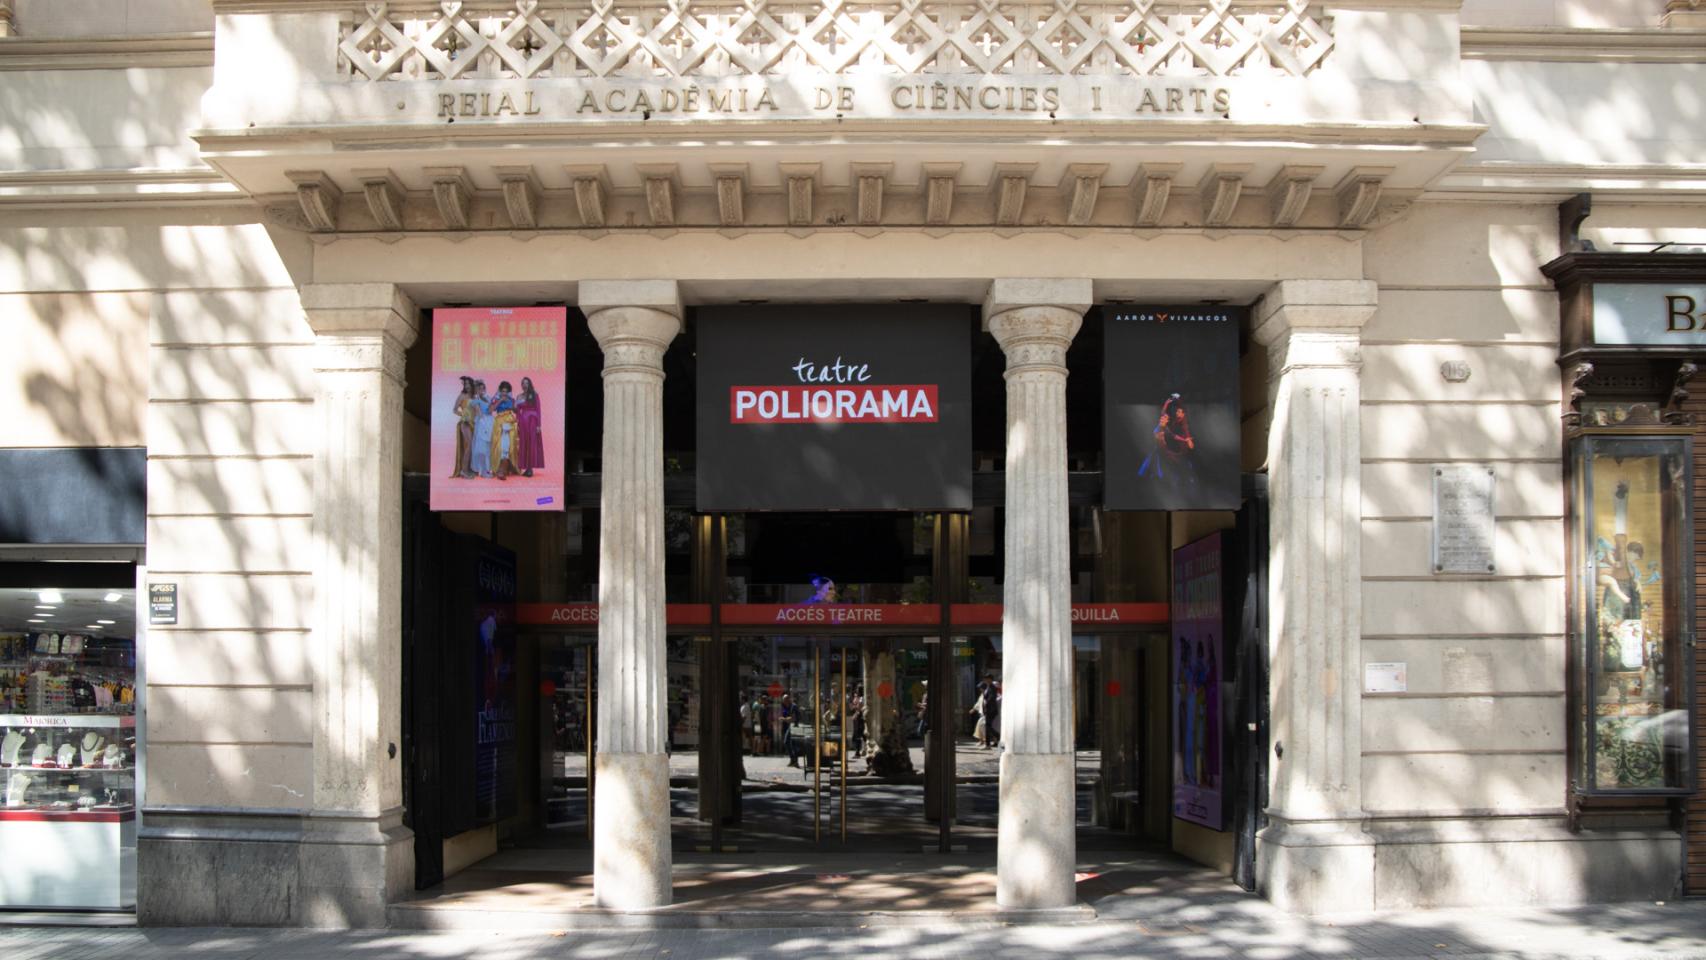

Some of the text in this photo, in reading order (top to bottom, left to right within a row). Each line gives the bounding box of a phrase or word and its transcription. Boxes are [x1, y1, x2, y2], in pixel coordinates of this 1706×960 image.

[437, 91, 541, 117] REIAL
[812, 86, 856, 111] DE
[890, 80, 1060, 112] CIÈNCIES
[1091, 86, 1102, 111] I
[1135, 87, 1231, 113] ARTS
[442, 336, 558, 371] EL CUENTO
[792, 356, 871, 383] teatre
[735, 389, 934, 419] POLIORAMA
[551, 605, 599, 621] ACCÉS
[776, 606, 883, 621] ACCÉS TEATRE
[1071, 607, 1120, 621] QUILLA
